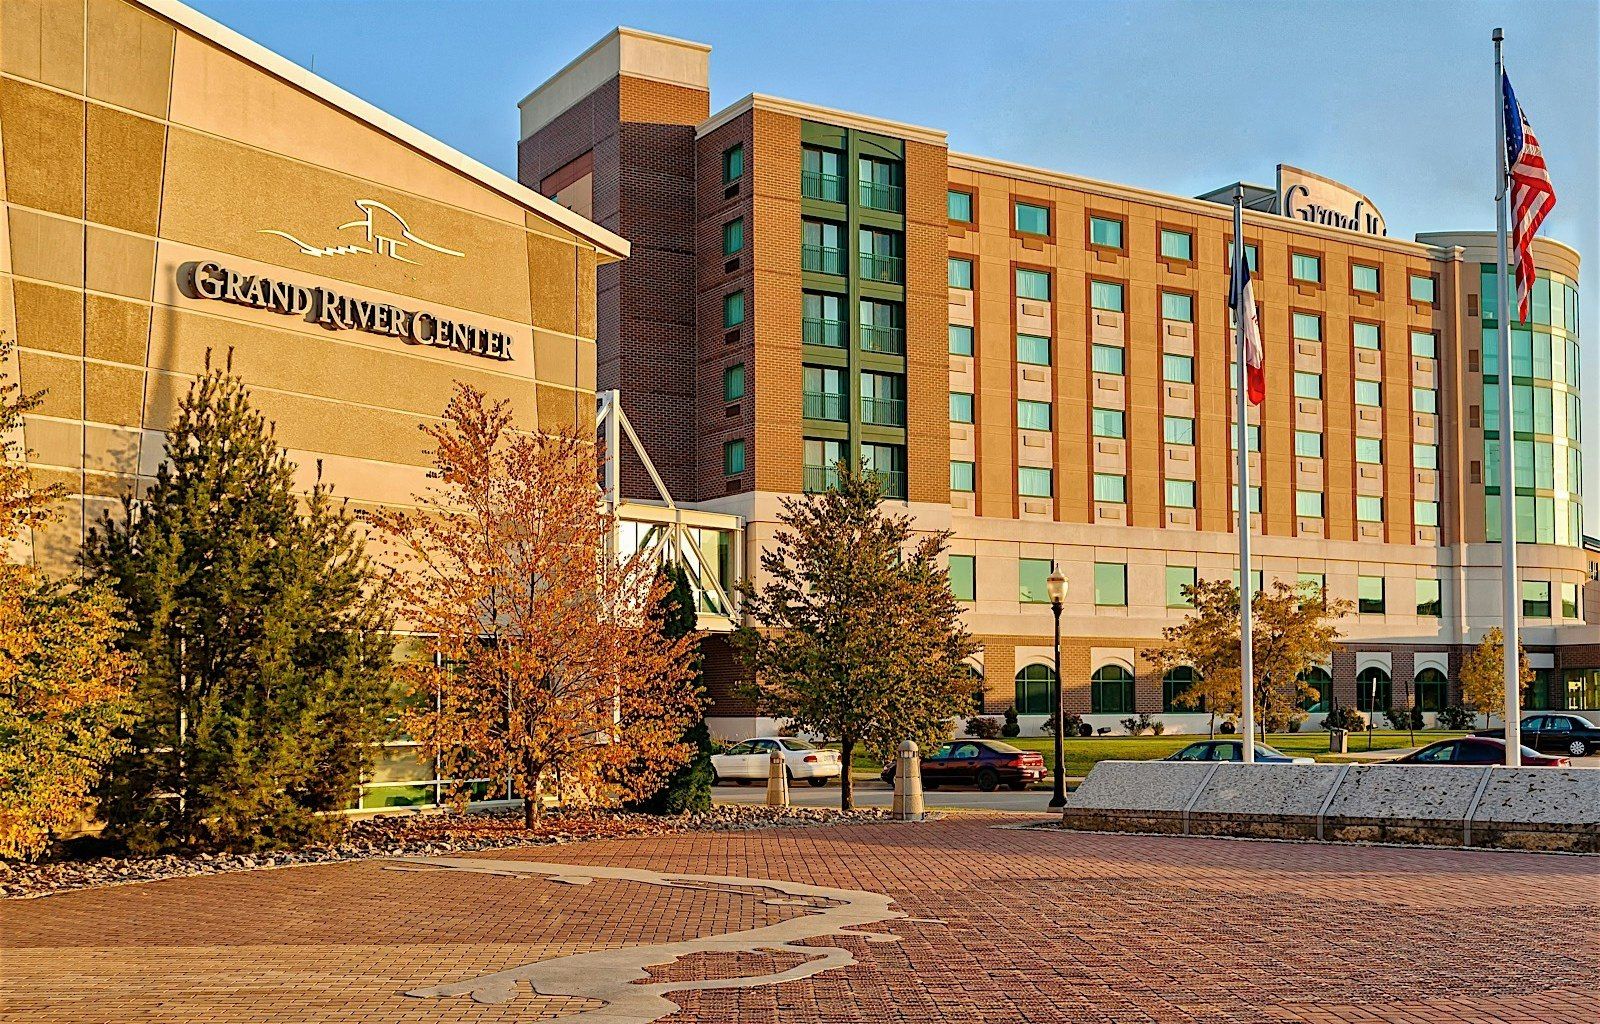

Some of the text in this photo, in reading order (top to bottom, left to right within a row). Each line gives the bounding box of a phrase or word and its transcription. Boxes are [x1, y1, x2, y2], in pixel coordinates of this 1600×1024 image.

[194, 259, 515, 361] GRAND RIVER CENTER
